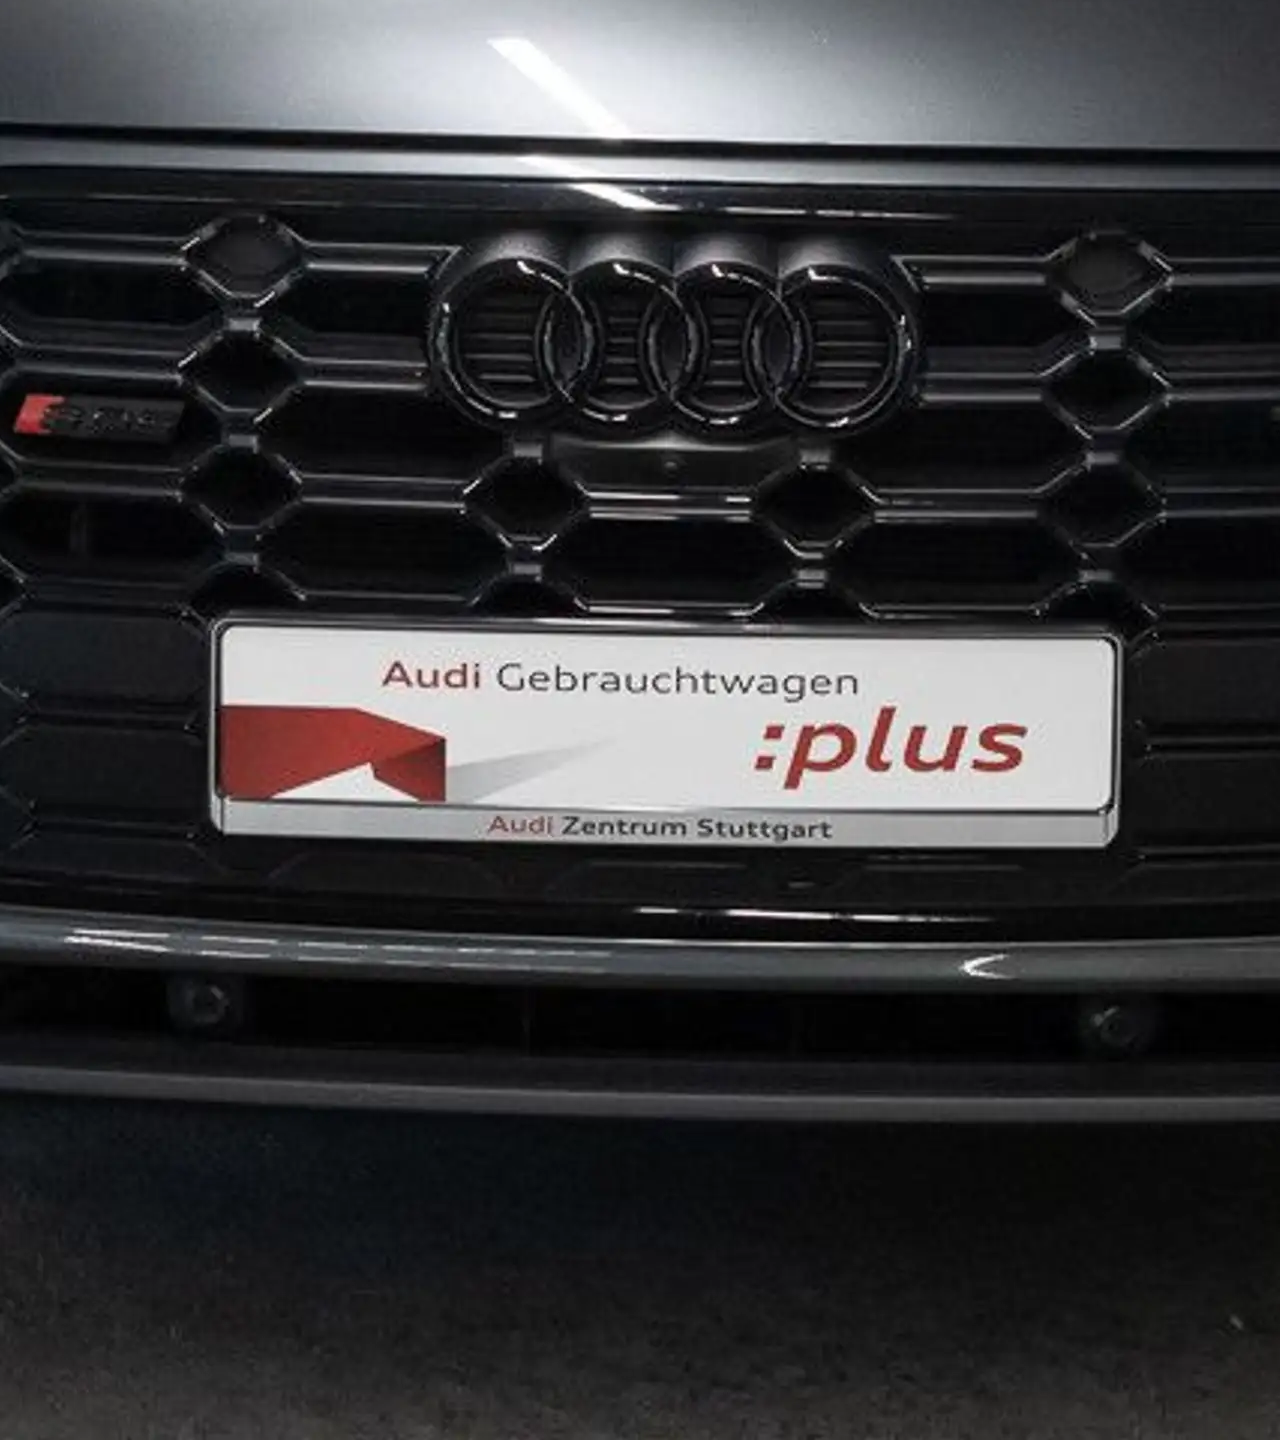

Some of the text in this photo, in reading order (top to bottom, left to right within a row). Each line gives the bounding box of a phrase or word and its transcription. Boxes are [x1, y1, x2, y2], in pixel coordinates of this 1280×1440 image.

[382, 661, 860, 705] Audi Gebrauchtwagen
[754, 705, 1030, 791] :plus
[487, 815, 834, 843] Audi Zentrum Stuttgart
